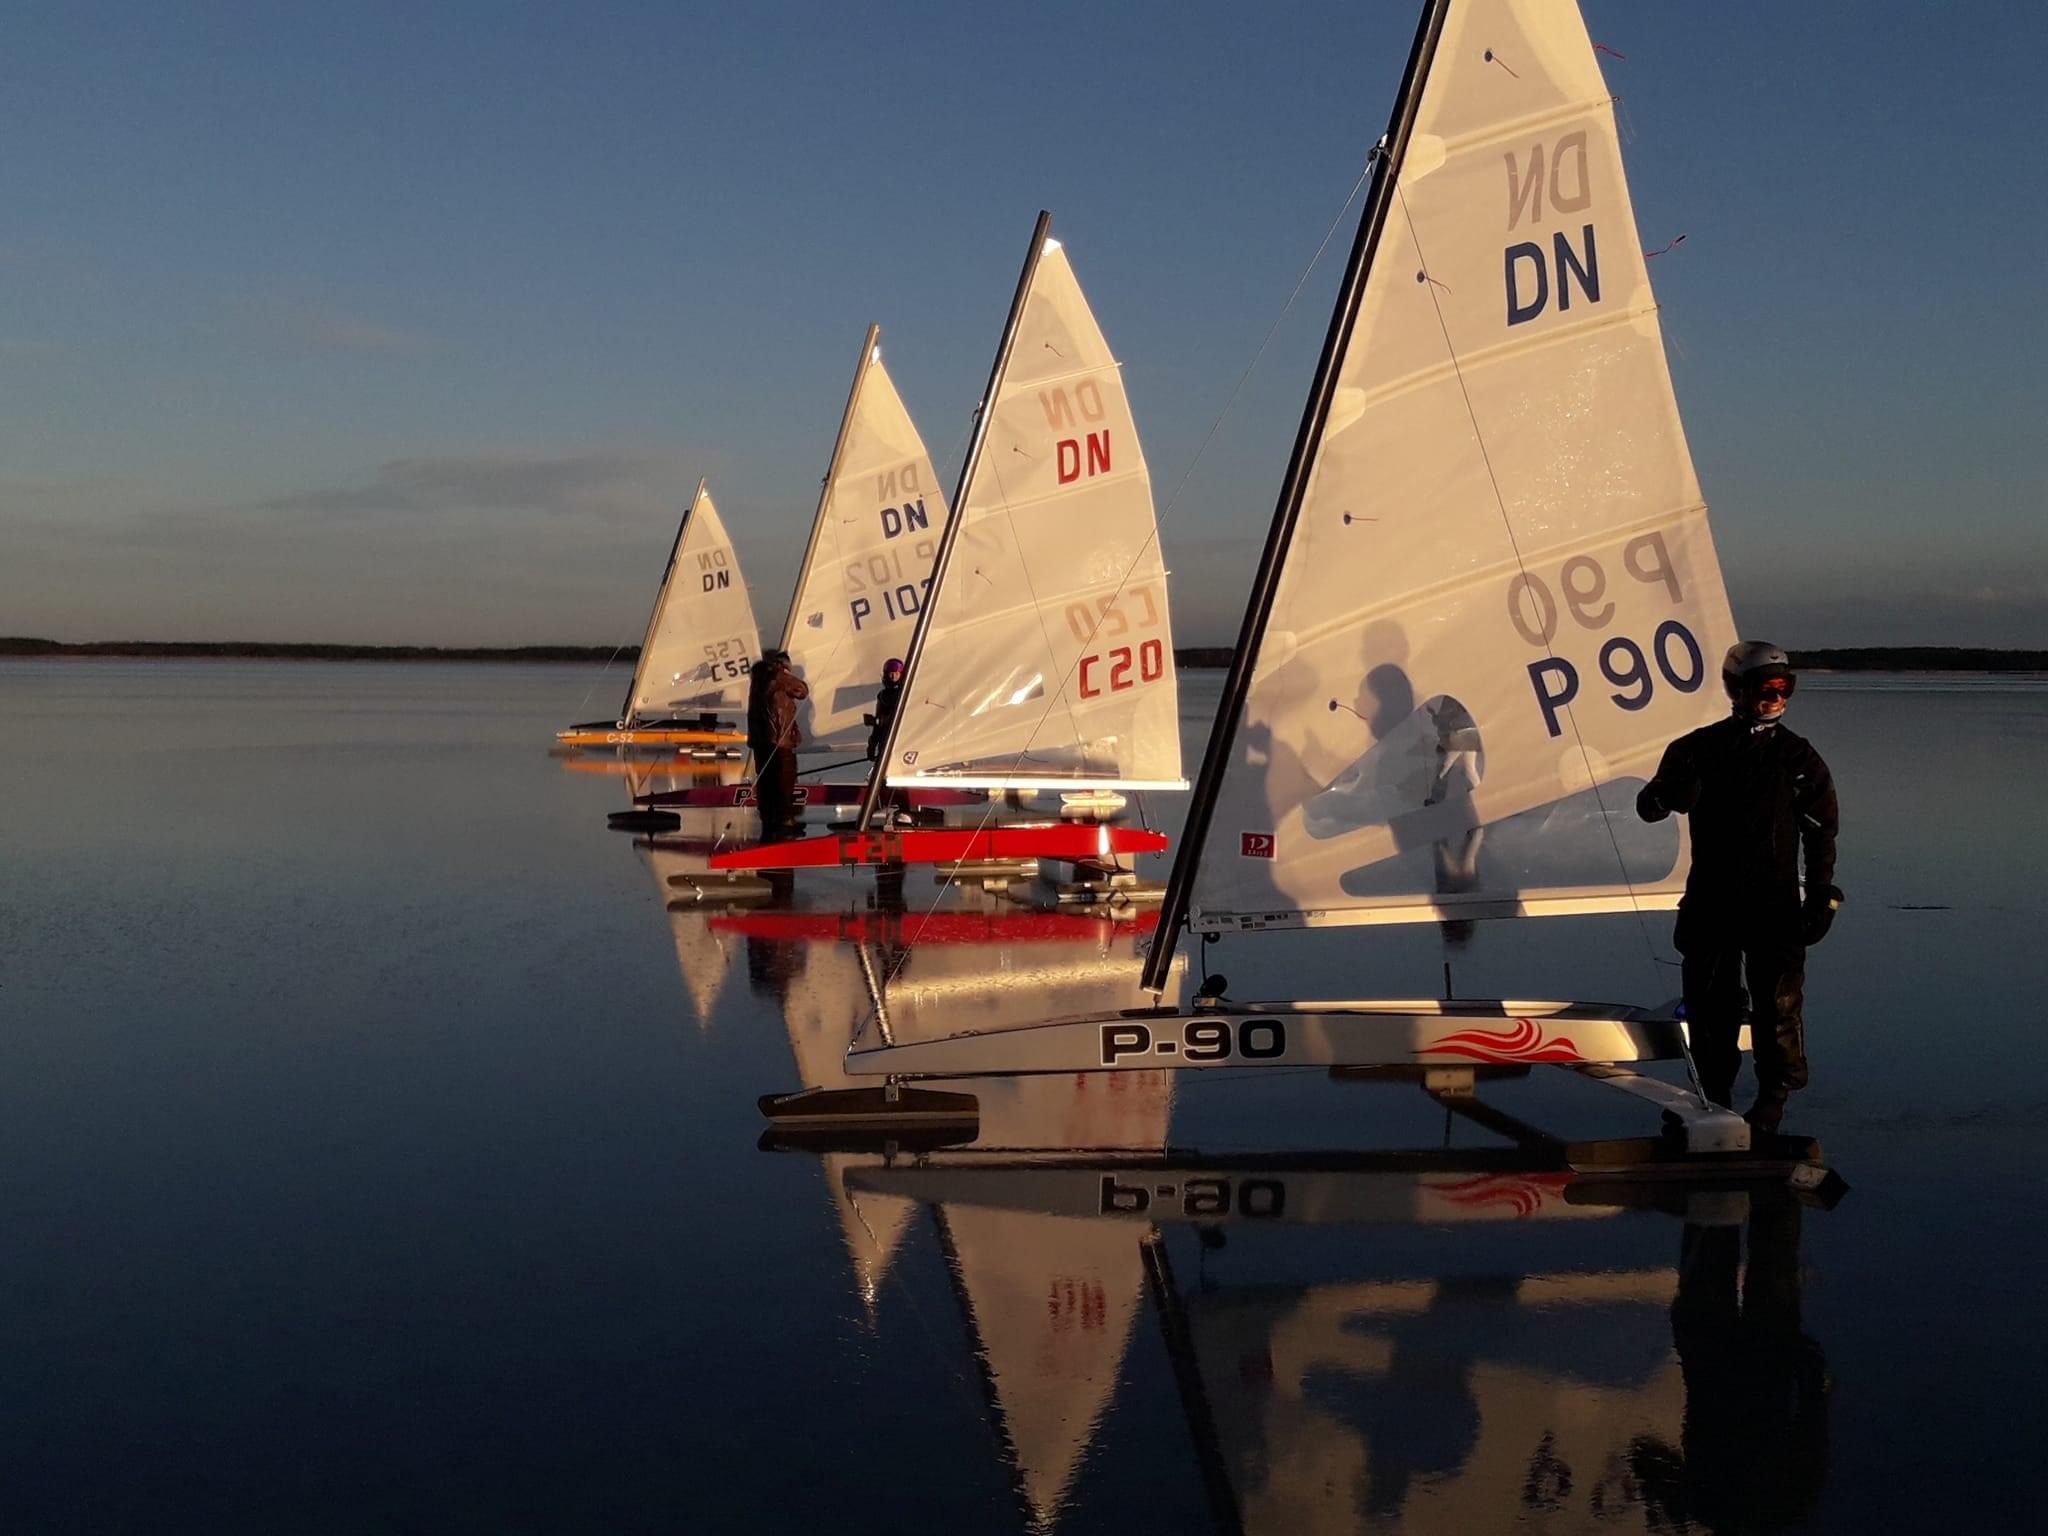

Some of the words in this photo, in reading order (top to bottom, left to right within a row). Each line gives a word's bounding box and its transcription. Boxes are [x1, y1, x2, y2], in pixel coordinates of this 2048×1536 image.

[1504, 223, 1600, 327] DN
[1056, 429, 1111, 485] DN
[880, 499, 929, 539] DN
[703, 570, 730, 593] DN
[1079, 639, 1164, 700] C20
[1100, 1018, 1286, 1066] P-90
